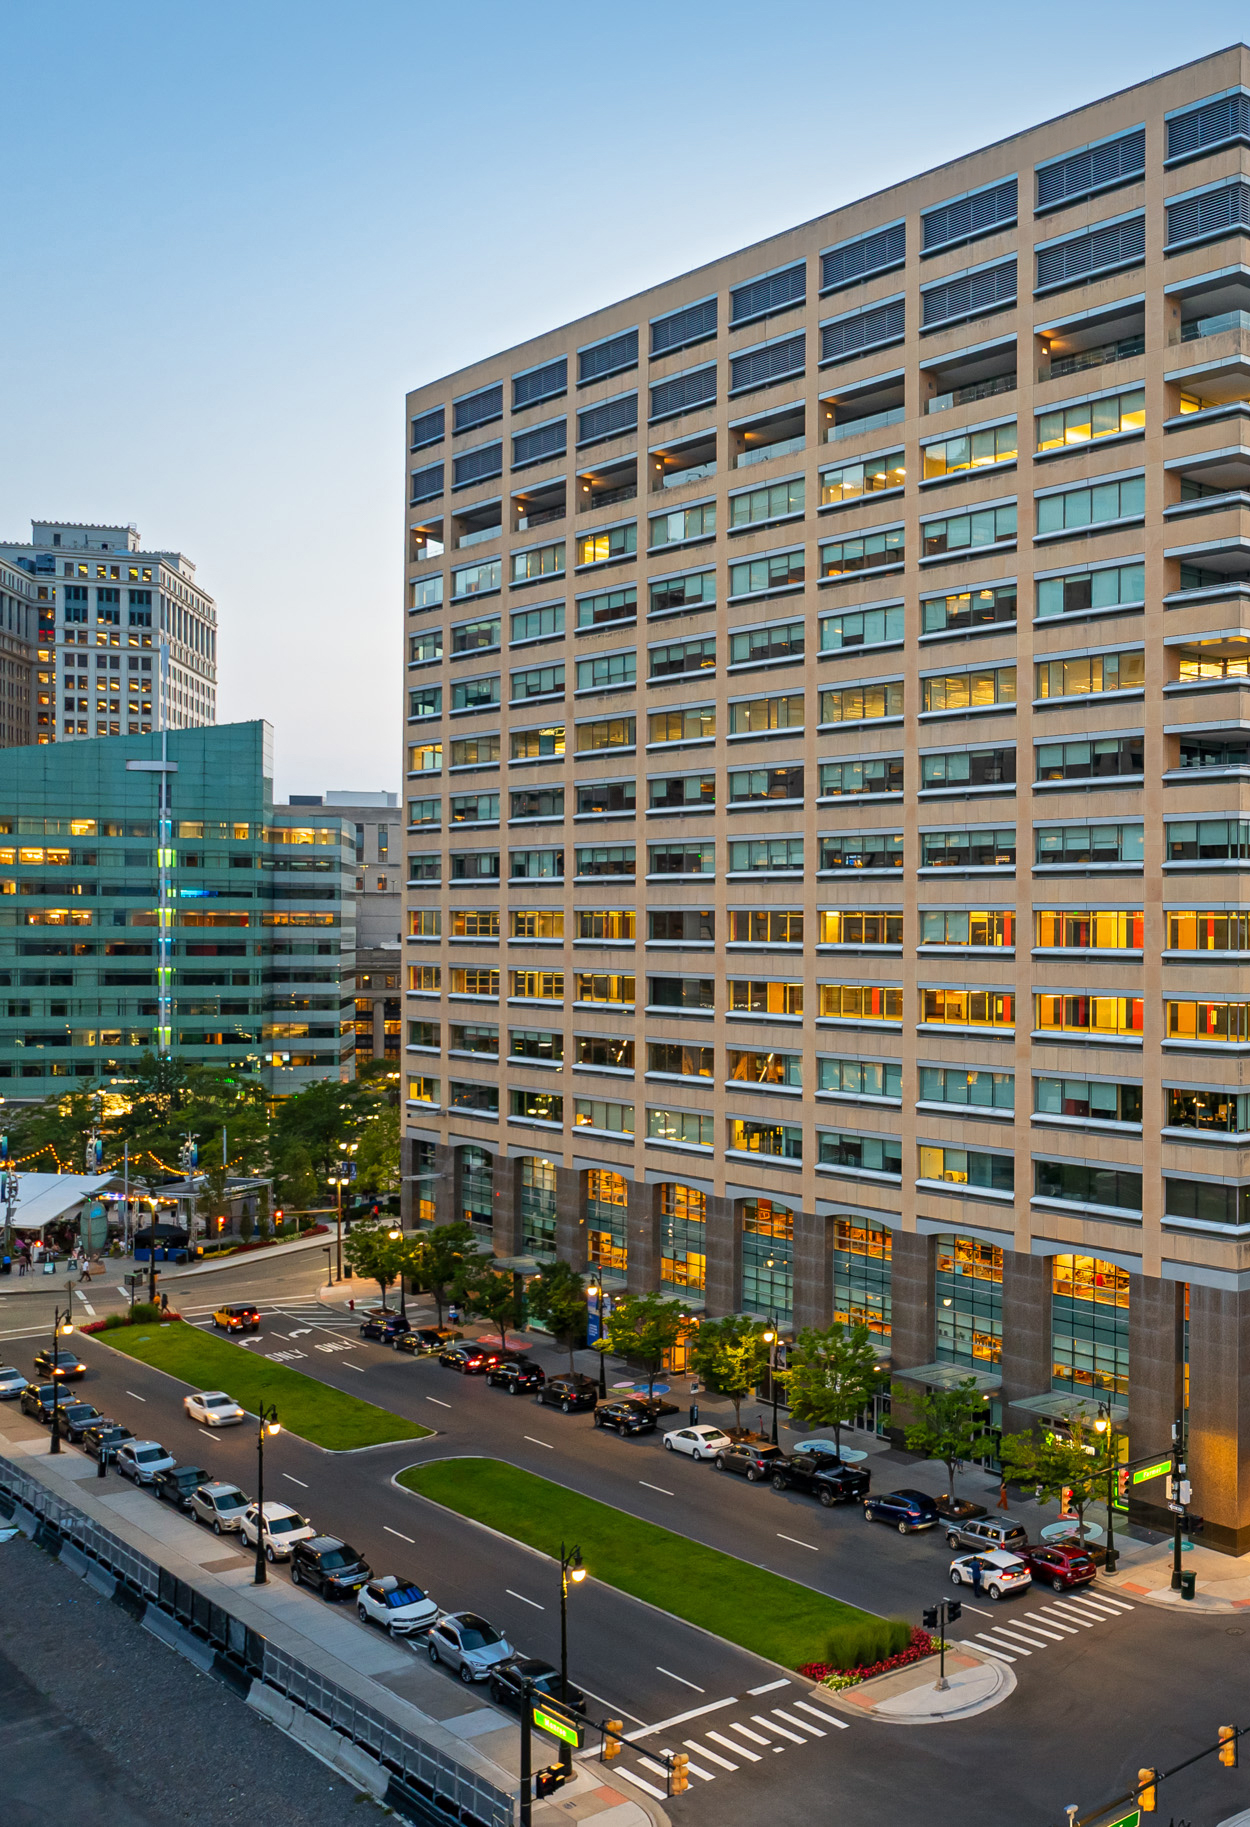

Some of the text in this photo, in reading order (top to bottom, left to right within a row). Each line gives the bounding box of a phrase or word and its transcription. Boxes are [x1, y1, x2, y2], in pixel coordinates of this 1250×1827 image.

[314, 1340, 357, 1353] ONLY
[264, 1349, 309, 1362] ONLY
[1143, 1467, 1162, 1478] Farmer
